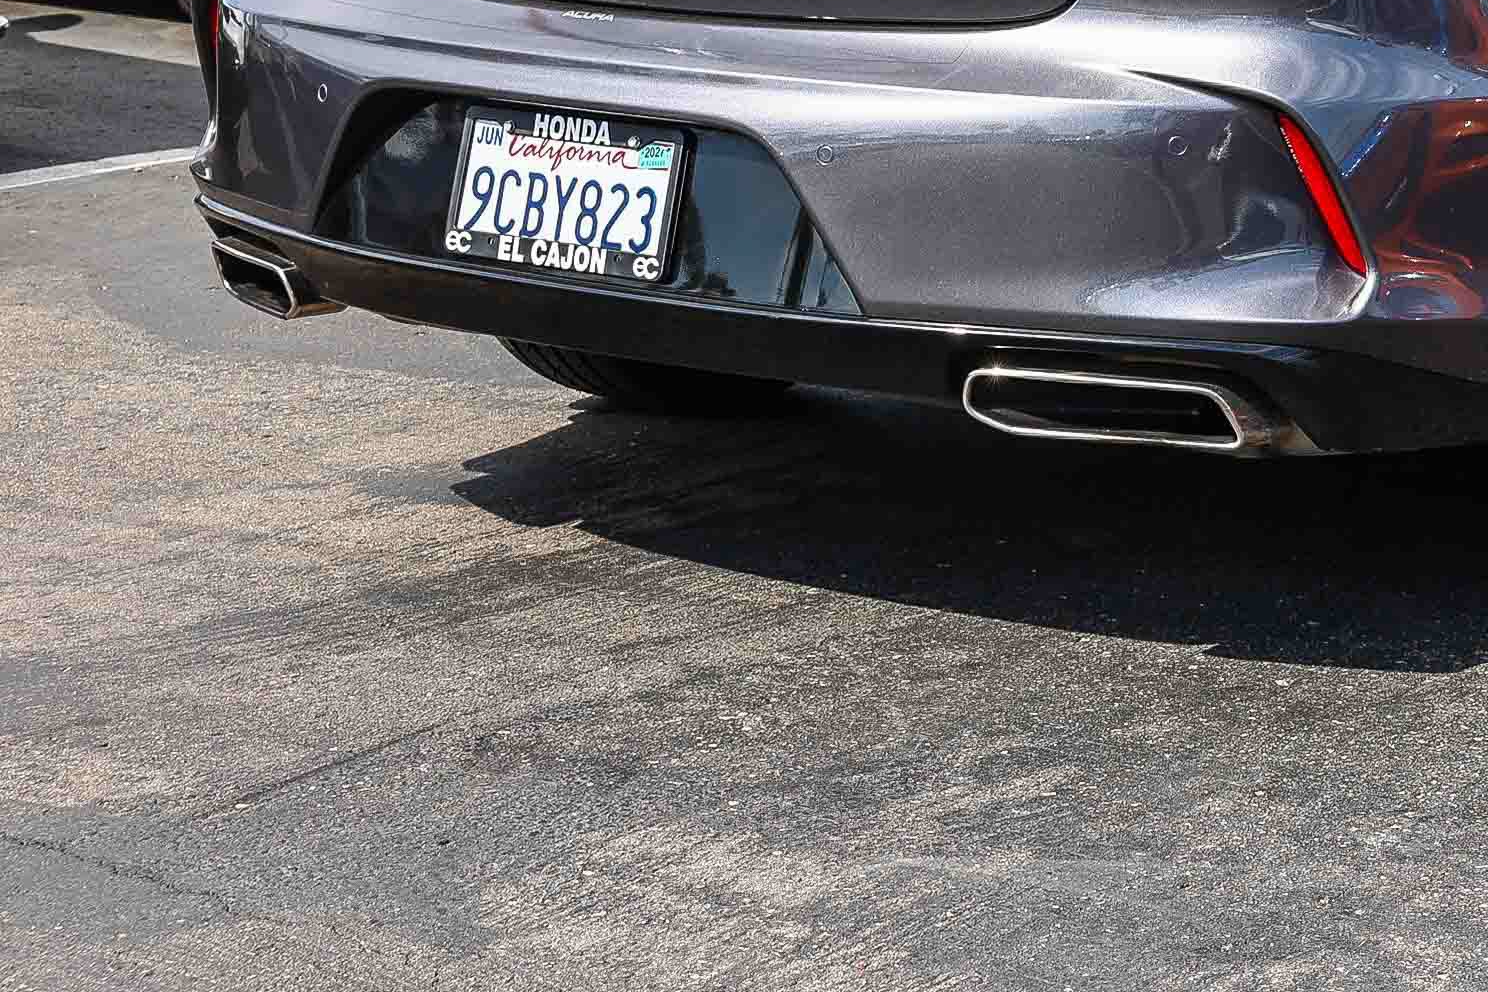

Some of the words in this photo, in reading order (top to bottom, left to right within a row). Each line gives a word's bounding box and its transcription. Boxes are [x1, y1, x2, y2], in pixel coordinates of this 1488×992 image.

[561, 10, 616, 22] ACURA
[476, 127, 504, 147] JUN
[532, 113, 612, 146] HONDA
[507, 133, 640, 171] California
[463, 165, 658, 254] 9CBY823
[497, 235, 525, 263] EL
[531, 239, 607, 275] CAJON
